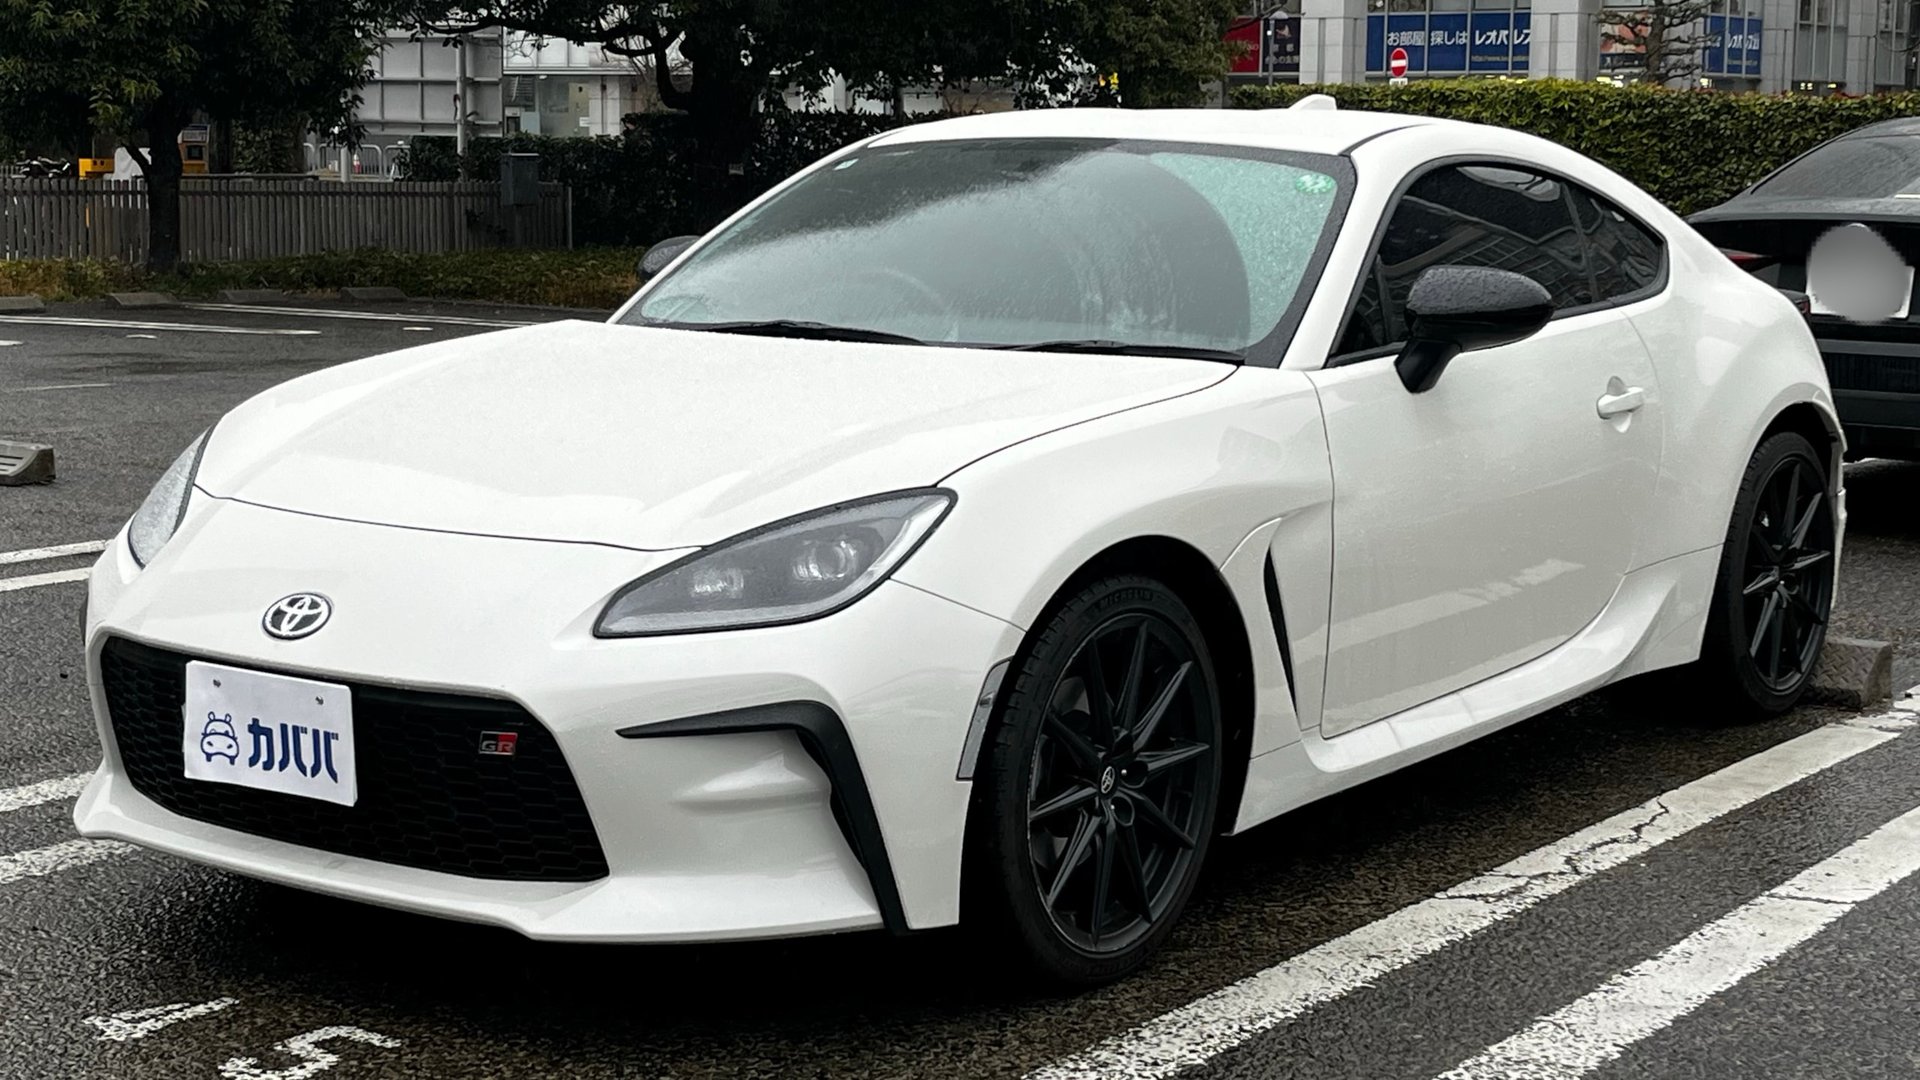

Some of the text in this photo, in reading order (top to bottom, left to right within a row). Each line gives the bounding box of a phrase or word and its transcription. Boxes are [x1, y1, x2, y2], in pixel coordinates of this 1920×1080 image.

[247, 717, 339, 784] カババ
[481, 740, 516, 753] GR
